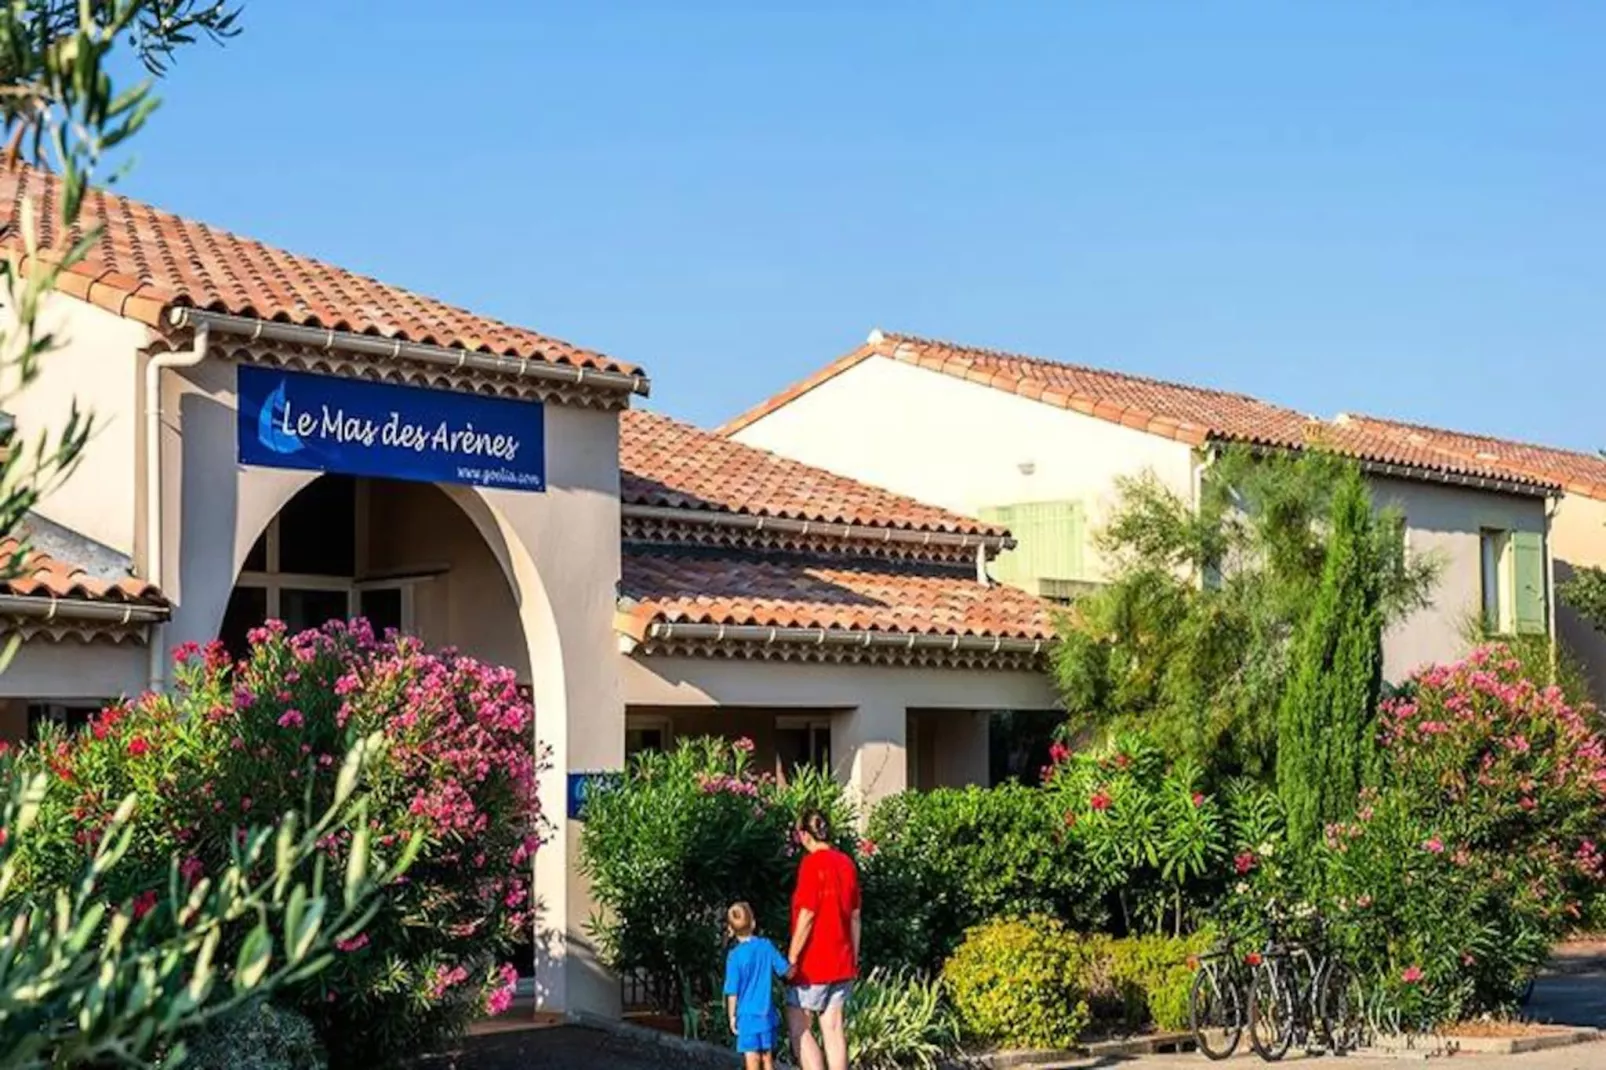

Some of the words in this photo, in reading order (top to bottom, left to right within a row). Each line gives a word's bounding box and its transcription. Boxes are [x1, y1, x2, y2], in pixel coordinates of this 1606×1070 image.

[281, 401, 317, 436] Le
[321, 404, 379, 447] Mas
[382, 411, 428, 452] des
[431, 420, 520, 461] Arènes
